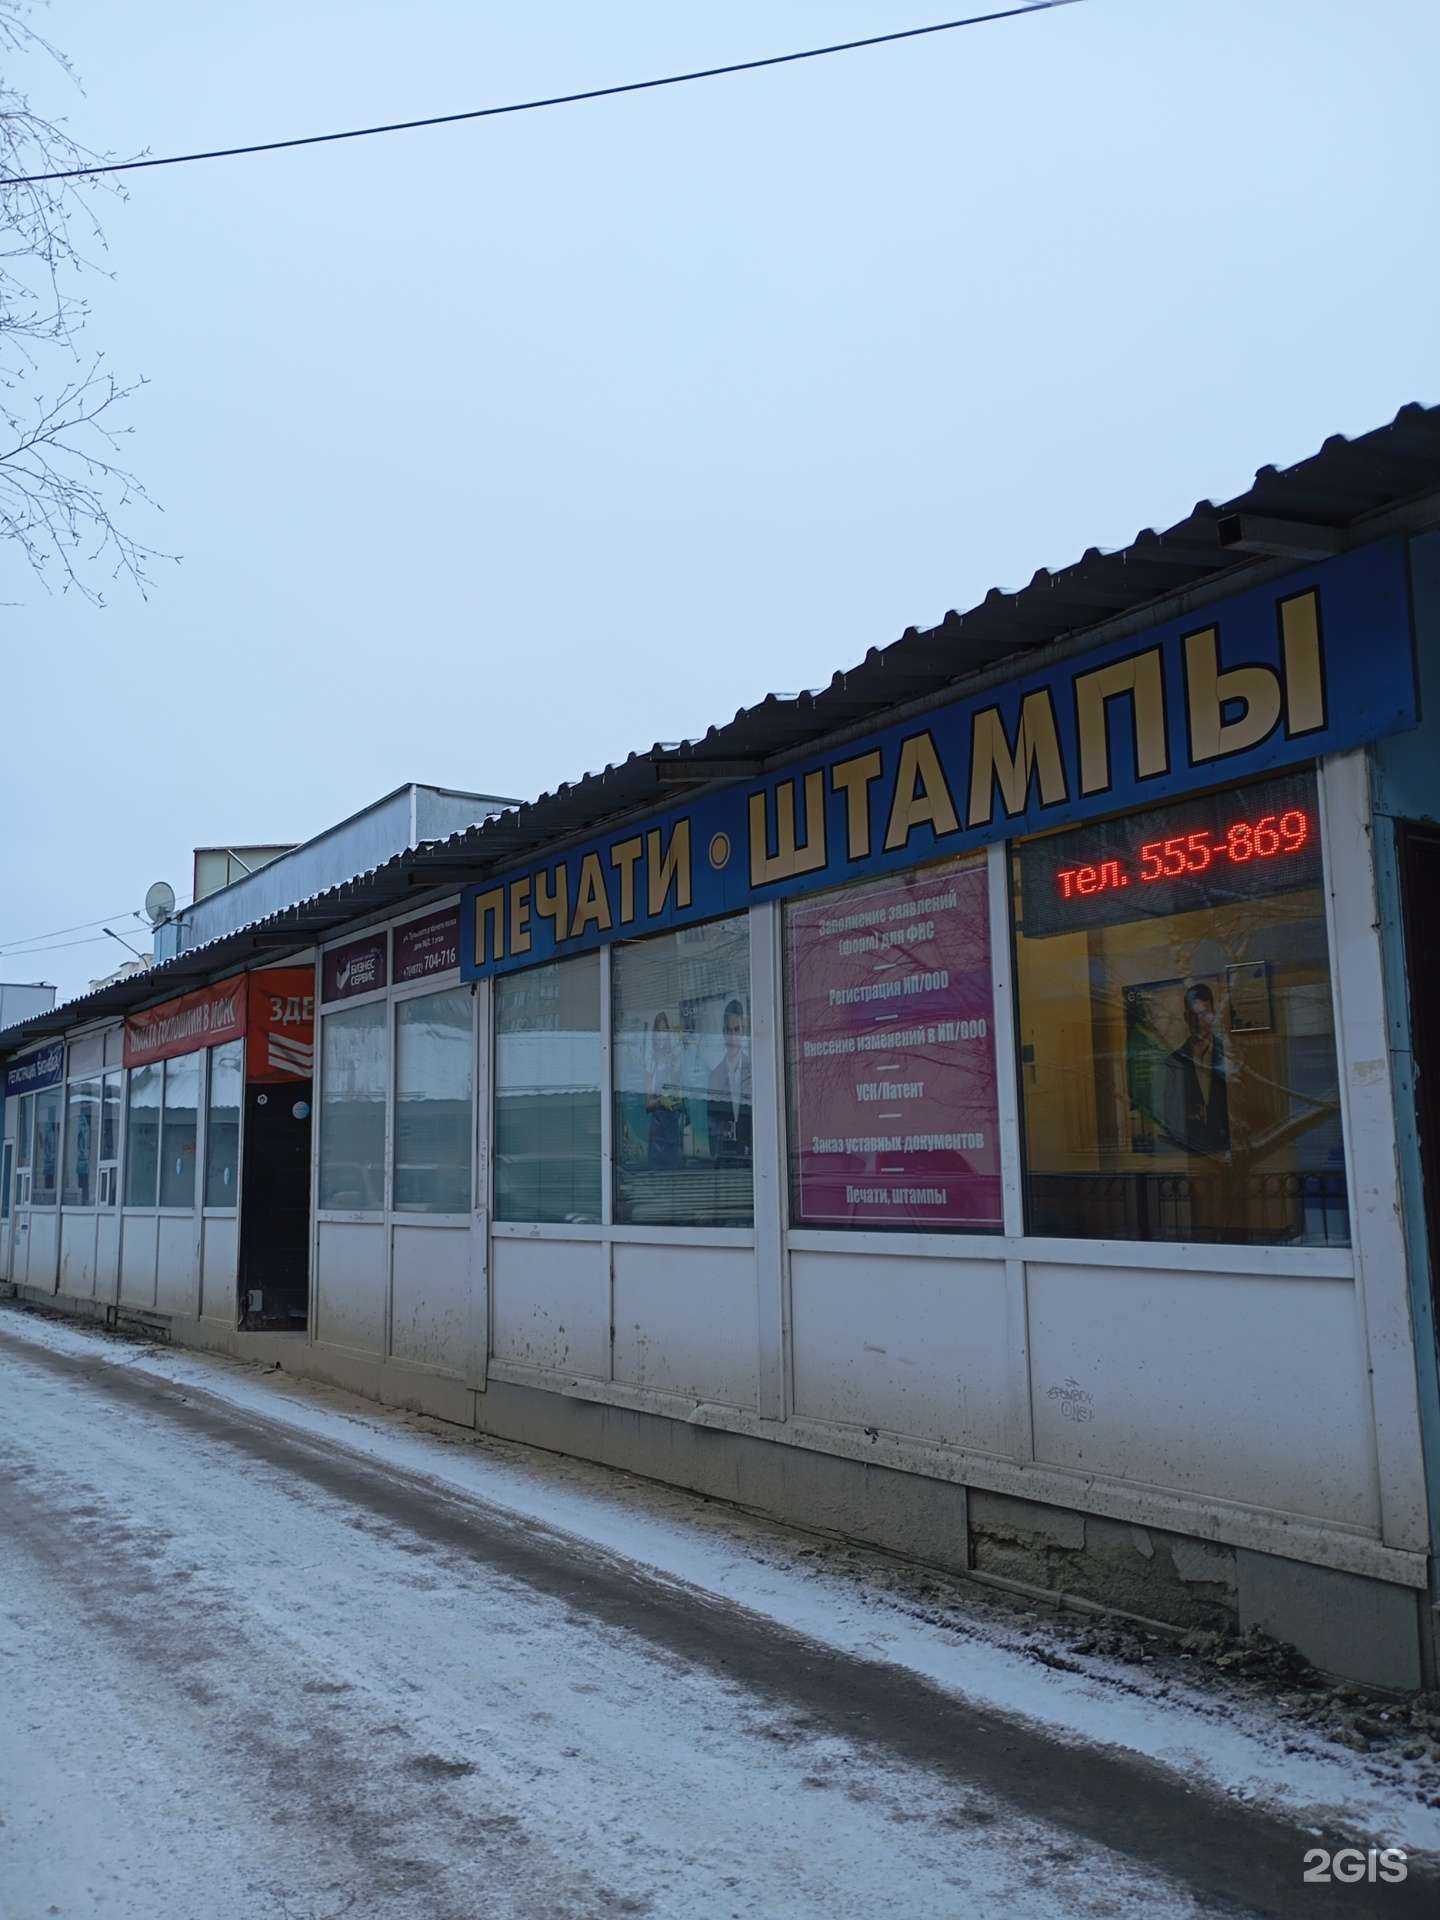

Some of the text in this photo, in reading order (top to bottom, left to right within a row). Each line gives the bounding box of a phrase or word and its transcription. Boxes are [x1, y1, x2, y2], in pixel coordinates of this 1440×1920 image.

[475, 587, 1326, 967] ПЕЧАТИ ШТАМПЫ
[1057, 809, 1310, 900] тел. 555-869
[819, 889, 957, 937] Заполнение заявлений
[839, 921, 935, 956] (форм) для ФНС
[424, 947, 456, 971] 704-716
[829, 971, 948, 1007] Регистрация ИП/ООО
[269, 996, 314, 1026] ЗДЕ
[804, 1033, 856, 1057] Внесение
[857, 1026, 925, 1052] изменений
[938, 1019, 987, 1043] ИП/ООО
[856, 1080, 925, 1102] УСН/Патент
[812, 1132, 985, 1155] Заказ уставных документов
[846, 1185, 947, 1206] Печати, штампы
